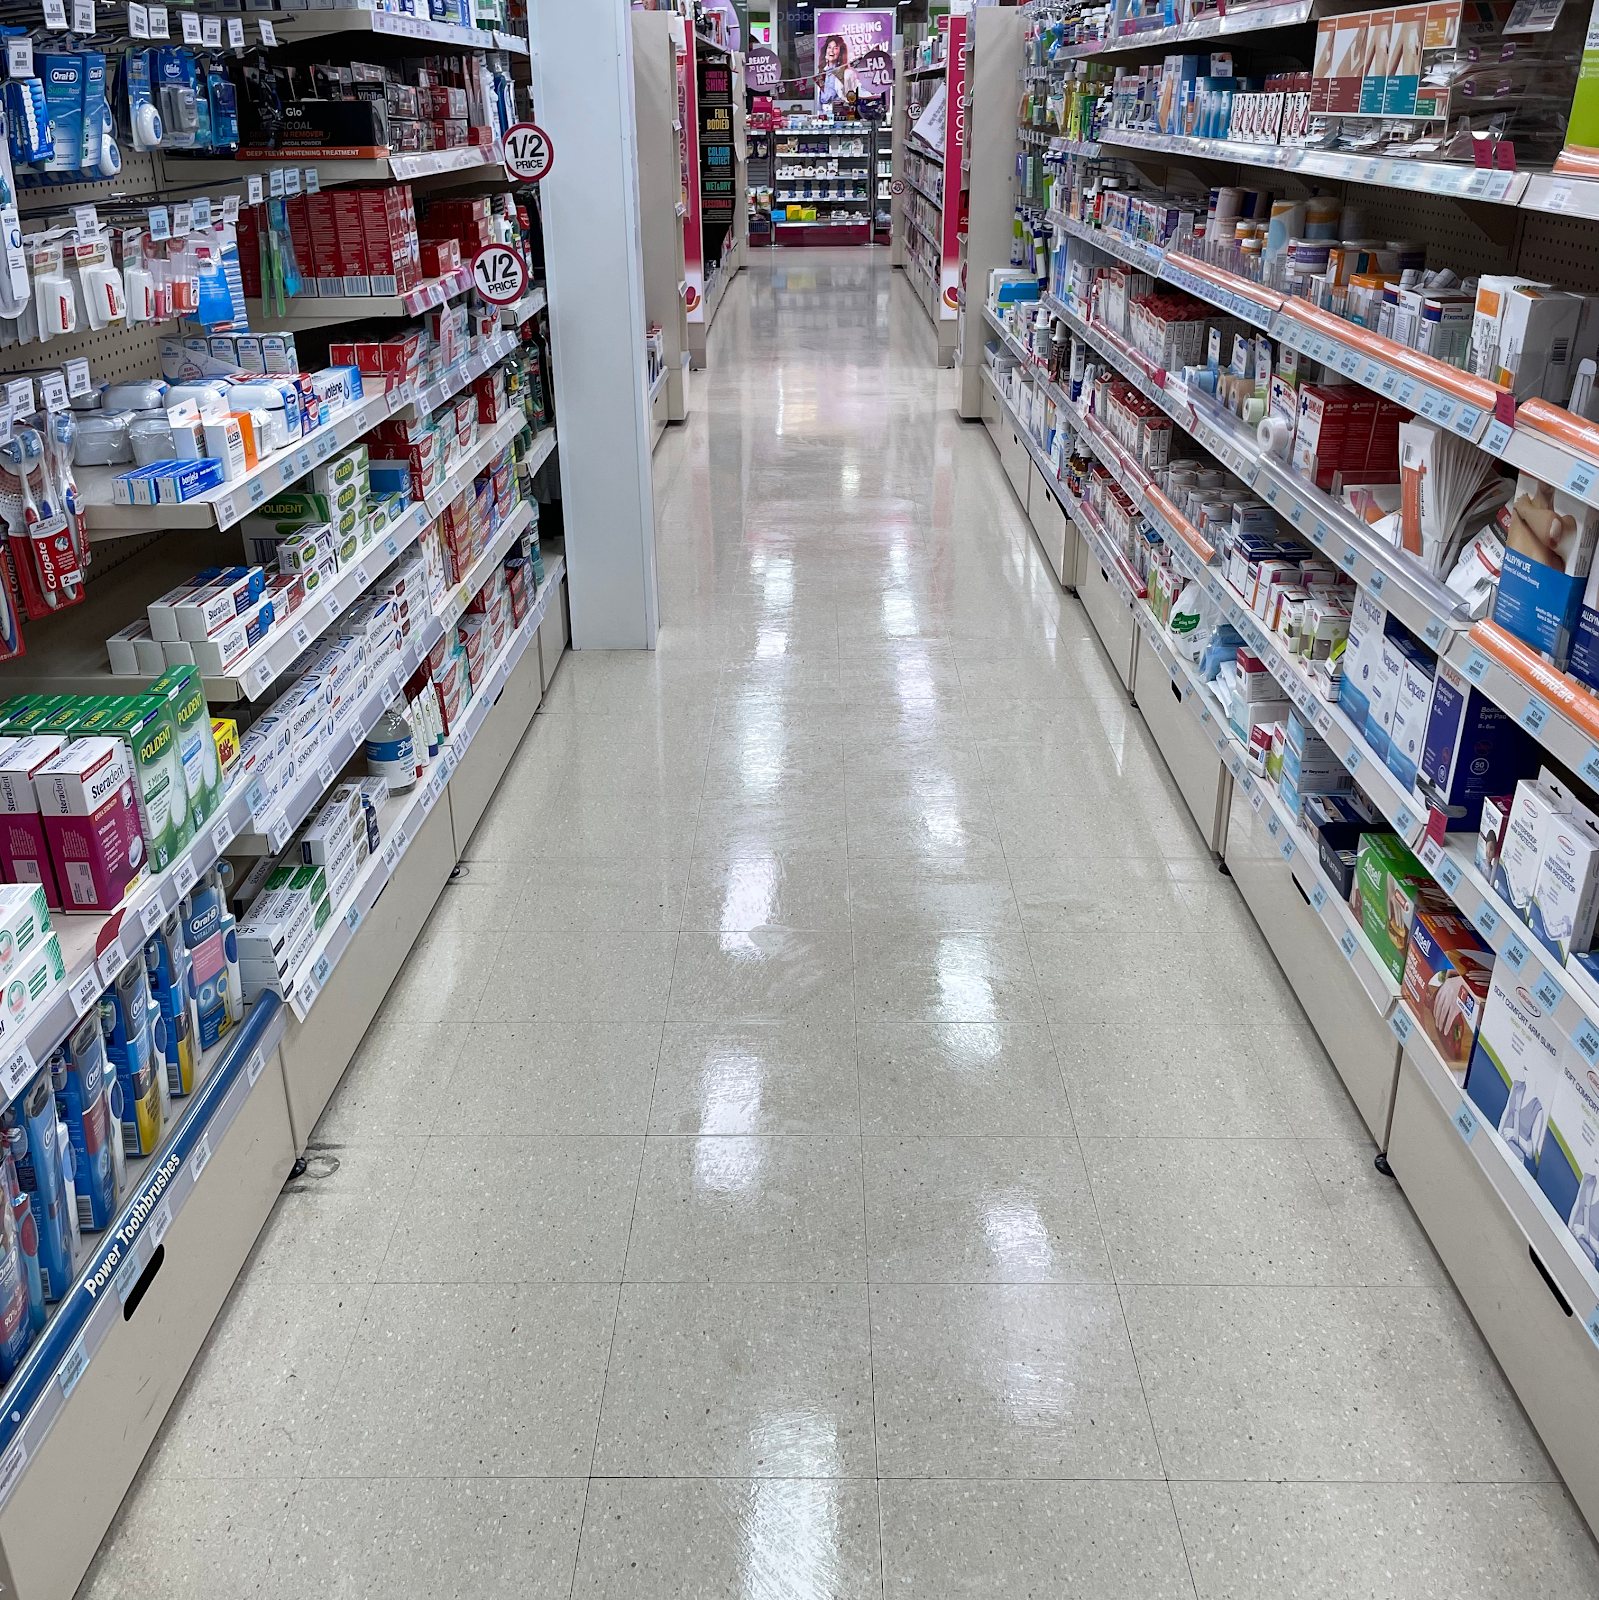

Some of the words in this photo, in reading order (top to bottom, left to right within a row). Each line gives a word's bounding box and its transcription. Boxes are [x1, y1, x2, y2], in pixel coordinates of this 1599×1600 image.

[842, 21, 882, 34] HELPING
[850, 34, 873, 45] YOU
[756, 63, 777, 73] LOOK
[866, 57, 886, 70] FAB
[52, 71, 75, 81] Oral-B
[705, 78, 729, 92] SHINE
[756, 72, 777, 85] RAD
[872, 70, 893, 85] 40
[357, 91, 383, 101] White
[285, 107, 303, 117] Glo
[714, 108, 729, 119] FULL
[909, 105, 921, 114] 1/2
[289, 130, 324, 138] REMOVER
[706, 119, 730, 130] BODIED
[322, 149, 360, 157] TREATMENT
[507, 134, 545, 159] 1/2
[707, 146, 730, 157] COLOUR
[515, 159, 544, 169] PRICE
[707, 156, 730, 165] PROTECT
[476, 253, 518, 283] 1/2
[487, 278, 518, 294] PRICE
[335, 461, 353, 477] POLIDENT
[258, 504, 303, 514] POLIDENT
[5, 543, 18, 593] Colgate
[39, 541, 58, 590] Colgate
[286, 553, 294, 568] MAX
[1505, 552, 1523, 568] ALLEVYN
[1522, 562, 1532, 574] LIFE
[63, 575, 71, 585] 2
[207, 598, 231, 621] Steradent
[1359, 592, 1382, 626] Nexcare
[1382, 647, 1400, 677] Nexcare
[1405, 671, 1426, 703] Nexcare
[1529, 664, 1576, 704] Woundcare
[177, 692, 202, 726] POLIDENT
[293, 705, 317, 734] SENSODYNE
[1479, 712, 1492, 721] Eye
[141, 725, 172, 763] POLIDENT
[297, 736, 319, 767] SENSODYNE
[1474, 761, 1485, 769] 50
[92, 764, 125, 800] Steradent
[152, 768, 169, 785] Minute
[1, 775, 16, 813] Steradent
[54, 778, 69, 814] Steradent
[317, 804, 338, 828] SENSODYNE
[1513, 819, 1537, 845] WATERPROOF
[1516, 831, 1538, 854] PROTECTOR
[1364, 857, 1383, 887] Ansell
[1548, 855, 1576, 884] WATERPROOF
[1552, 869, 1576, 895] PROTECTOR
[249, 892, 274, 920] SENSODYNE
[275, 892, 298, 920] SENSODYNE
[192, 908, 217, 930] Oral-B
[1413, 926, 1432, 955] Ansell
[1493, 984, 1506, 1000] SOFT
[1505, 998, 1529, 1026] COMFORT
[1527, 1023, 1541, 1040] ARM
[1540, 1036, 1557, 1057] SLING
[9, 1054, 24, 1074] $9.99
[1563, 1066, 1577, 1085] SOFT
[83, 1244, 122, 1299] Power
[115, 1152, 181, 1246] Toothbrushes
[4, 1309, 18, 1328] 90%
